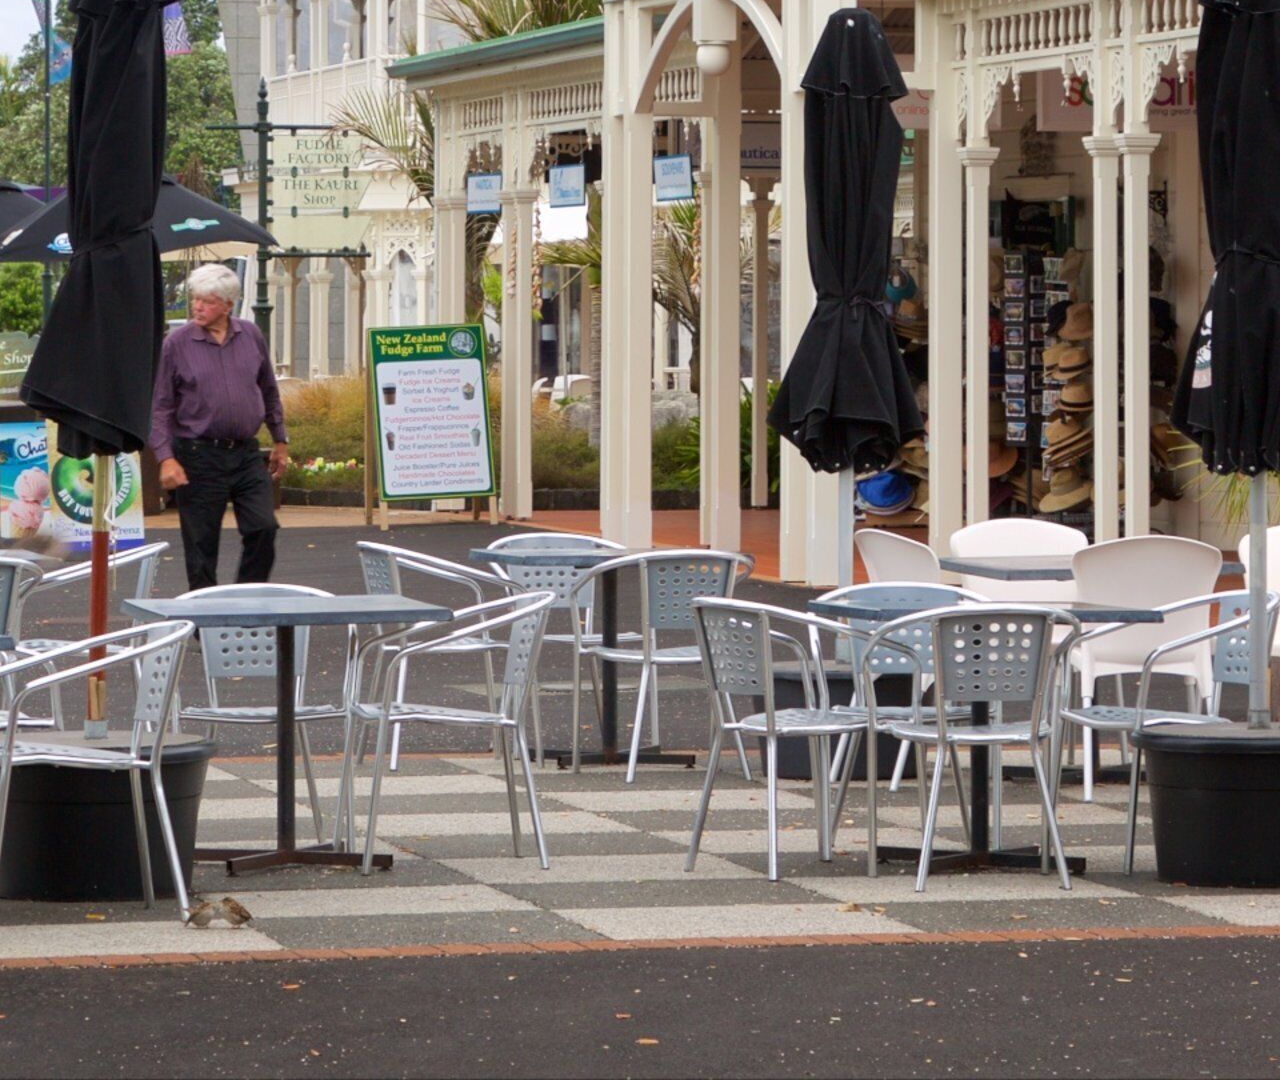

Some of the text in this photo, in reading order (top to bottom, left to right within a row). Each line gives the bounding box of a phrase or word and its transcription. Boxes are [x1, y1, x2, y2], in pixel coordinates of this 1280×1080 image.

[288, 153, 351, 164] FACTORY
[282, 179, 359, 190] THE KAURI
[304, 194, 336, 204] SHOP
[376, 332, 447, 345] New Zealand
[381, 344, 443, 356] Fudge Farm
